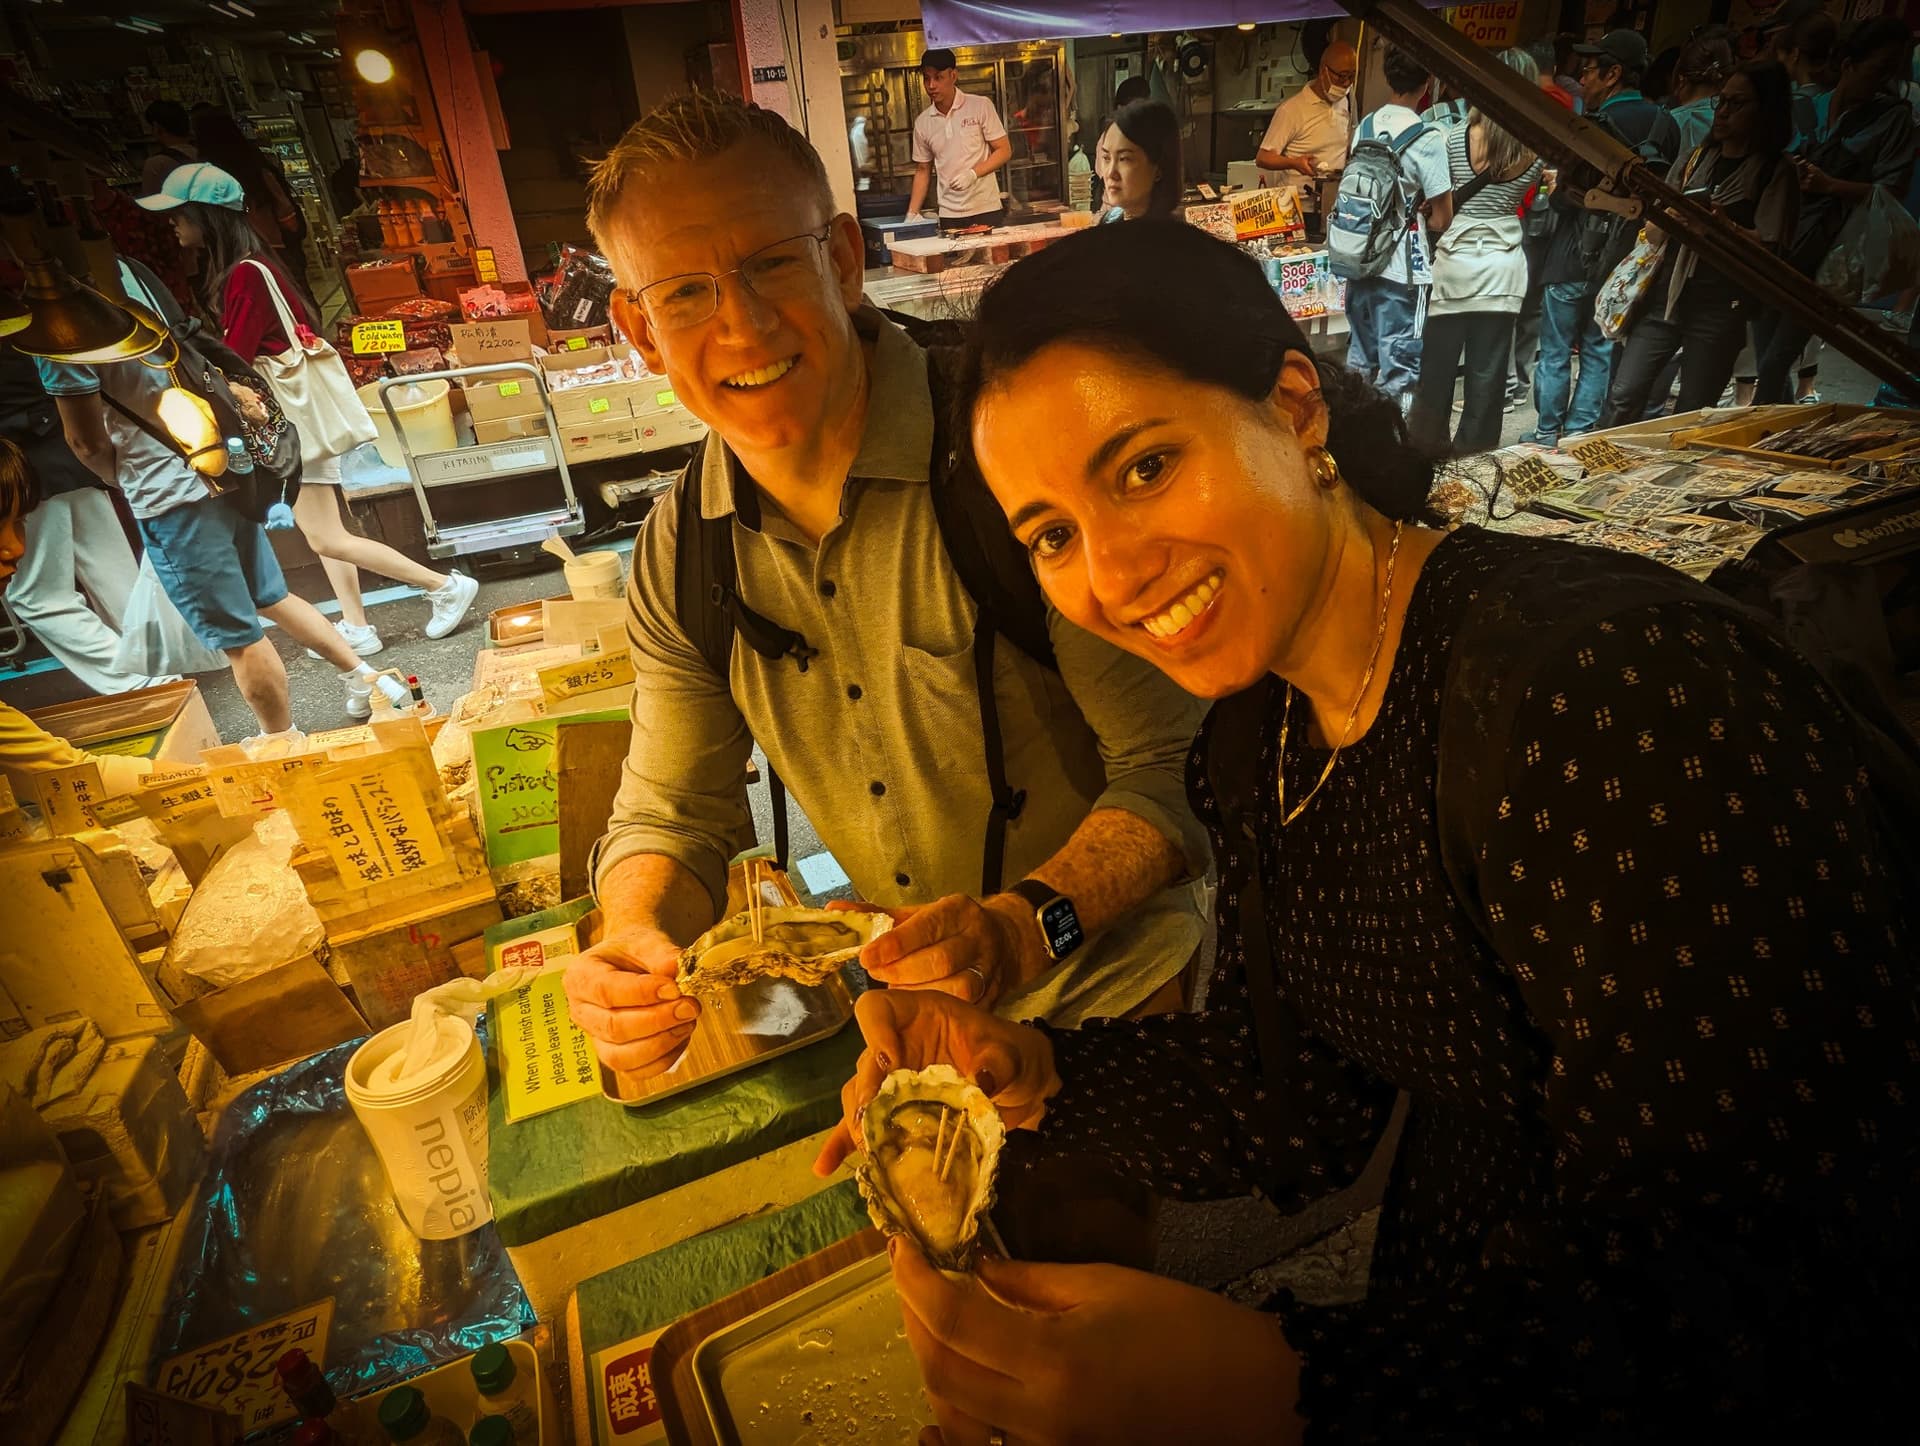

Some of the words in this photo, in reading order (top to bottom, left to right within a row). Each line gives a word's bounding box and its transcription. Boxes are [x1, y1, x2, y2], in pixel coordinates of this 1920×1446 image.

[1460, 1, 1518, 19] Grilled
[1464, 21, 1506, 40] Corn
[1235, 199, 1274, 224] NATURALLY
[1255, 211, 1275, 229] FOAM
[1282, 262, 1314, 278] Soda
[1283, 277, 1308, 291] pop
[362, 341, 387, 350] 120
[565, 668, 613, 689] 銀だら
[321, 796, 383, 881] 塩味と甘味の
[543, 992, 556, 1018] there
[520, 1013, 535, 1042] finish
[544, 1017, 557, 1027] it
[548, 1026, 561, 1052] leave
[525, 1041, 541, 1062] you
[526, 1063, 541, 1095] When
[551, 1052, 569, 1085] please
[414, 1117, 476, 1231] nepia
